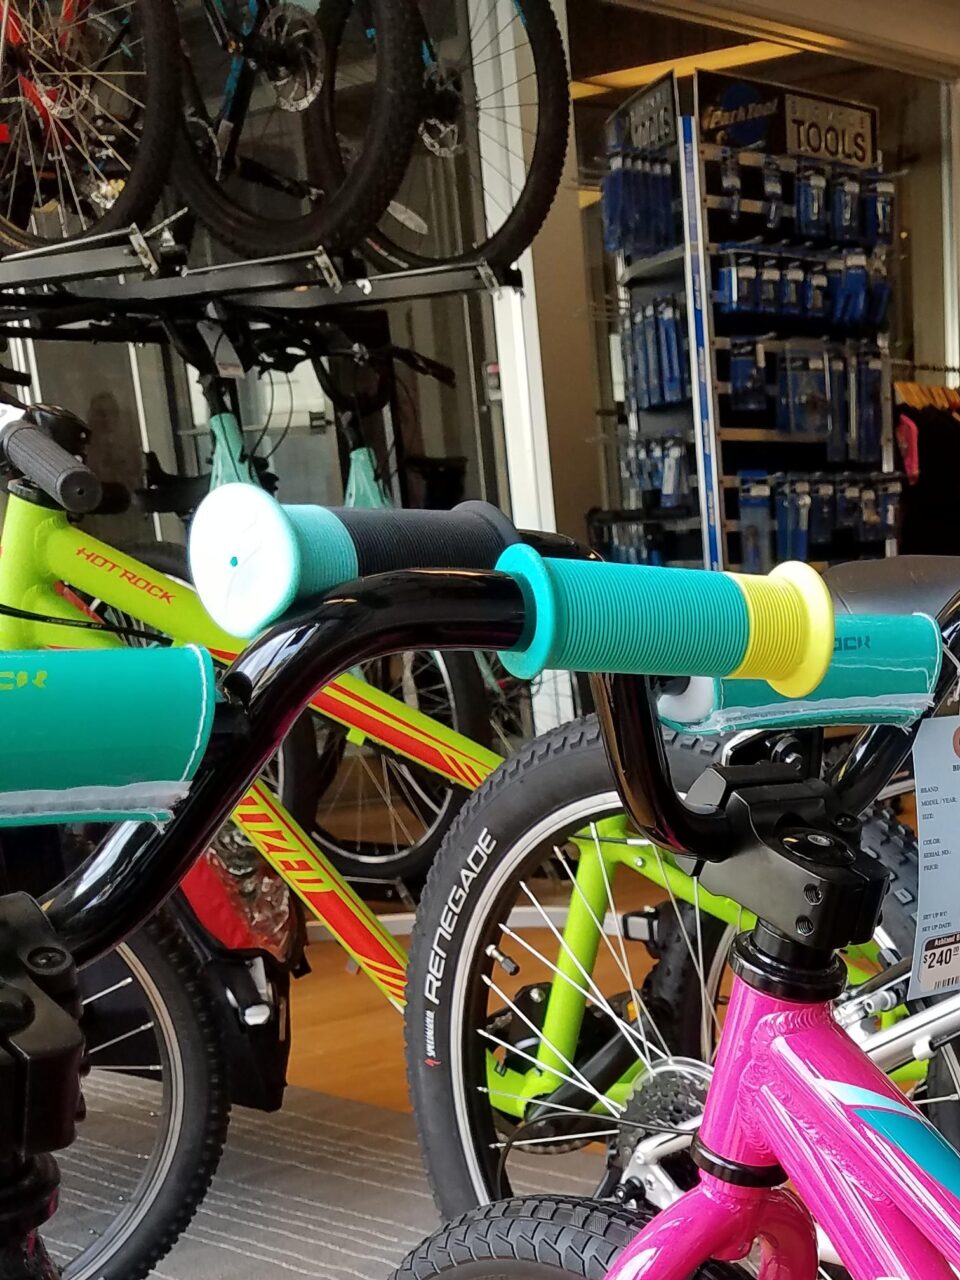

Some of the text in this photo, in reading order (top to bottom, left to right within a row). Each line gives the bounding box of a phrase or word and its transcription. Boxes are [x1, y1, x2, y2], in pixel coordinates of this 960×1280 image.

[791, 118, 867, 163] TOOLS
[76, 547, 177, 605] HOT ROCK
[424, 827, 496, 1005] RENEGADE
[923, 948, 952, 969] $240
